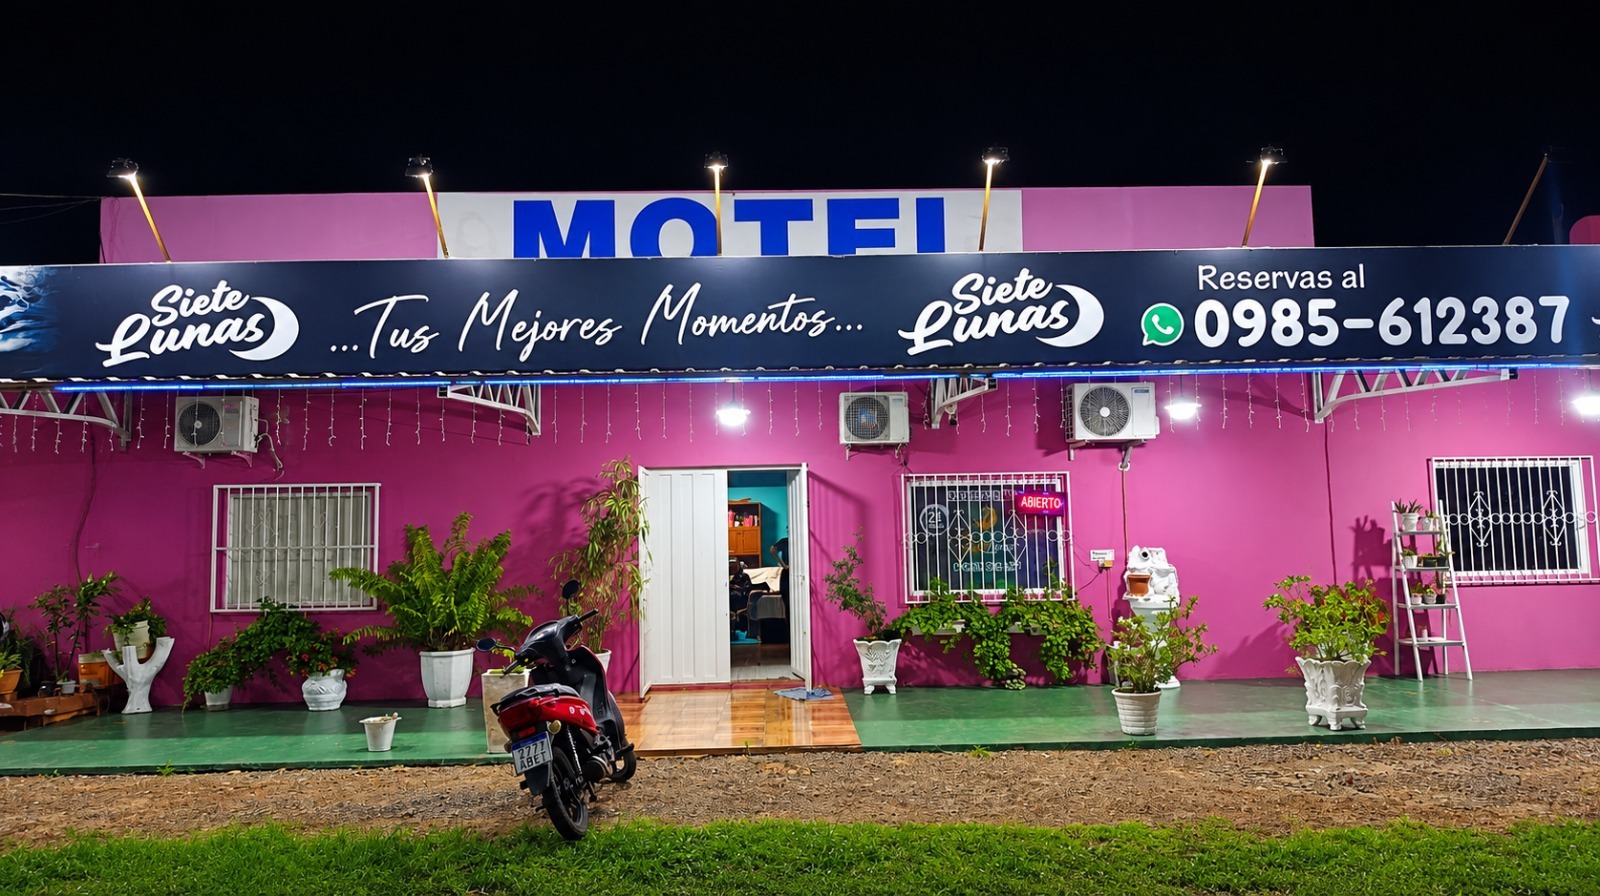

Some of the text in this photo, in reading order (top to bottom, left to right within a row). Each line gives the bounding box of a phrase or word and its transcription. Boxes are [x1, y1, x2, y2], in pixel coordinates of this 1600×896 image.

[951, 267, 1053, 315] Siete
[1198, 263, 1365, 291] Reservas al
[150, 279, 250, 327] Siete
[458, 288, 623, 362] Mejores
[640, 282, 863, 346] Momentos...
[1194, 295, 1570, 348] 0985-612387
[95, 313, 265, 368] Lunas
[897, 300, 1069, 356] Lunas
[1020, 495, 1062, 509] ABIERTO
[520, 750, 547, 770] ABET
